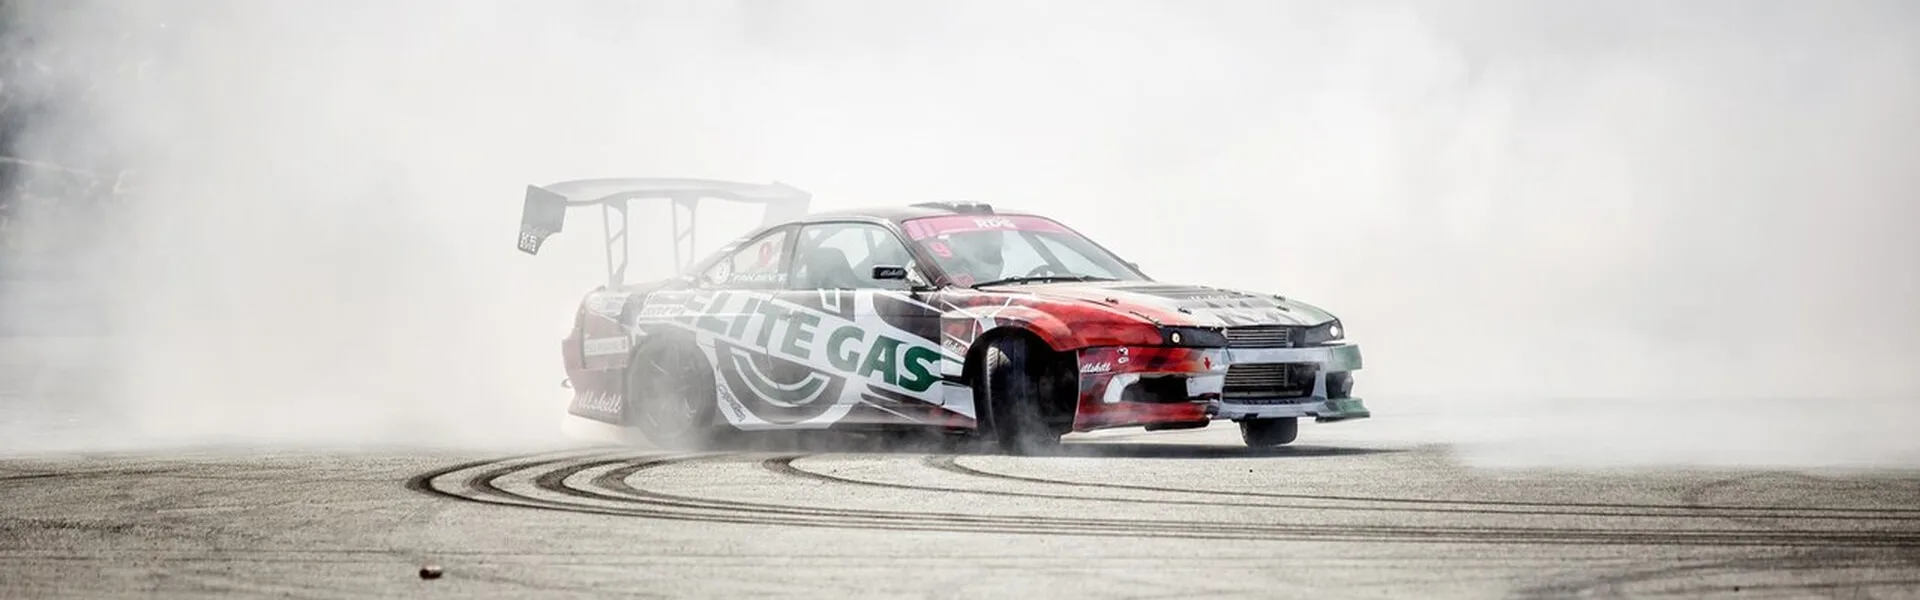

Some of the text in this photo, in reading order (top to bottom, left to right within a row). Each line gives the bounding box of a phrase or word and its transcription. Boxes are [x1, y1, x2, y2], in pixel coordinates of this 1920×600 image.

[930, 242, 952, 258] 9
[675, 291, 946, 392] ELITE GAS
